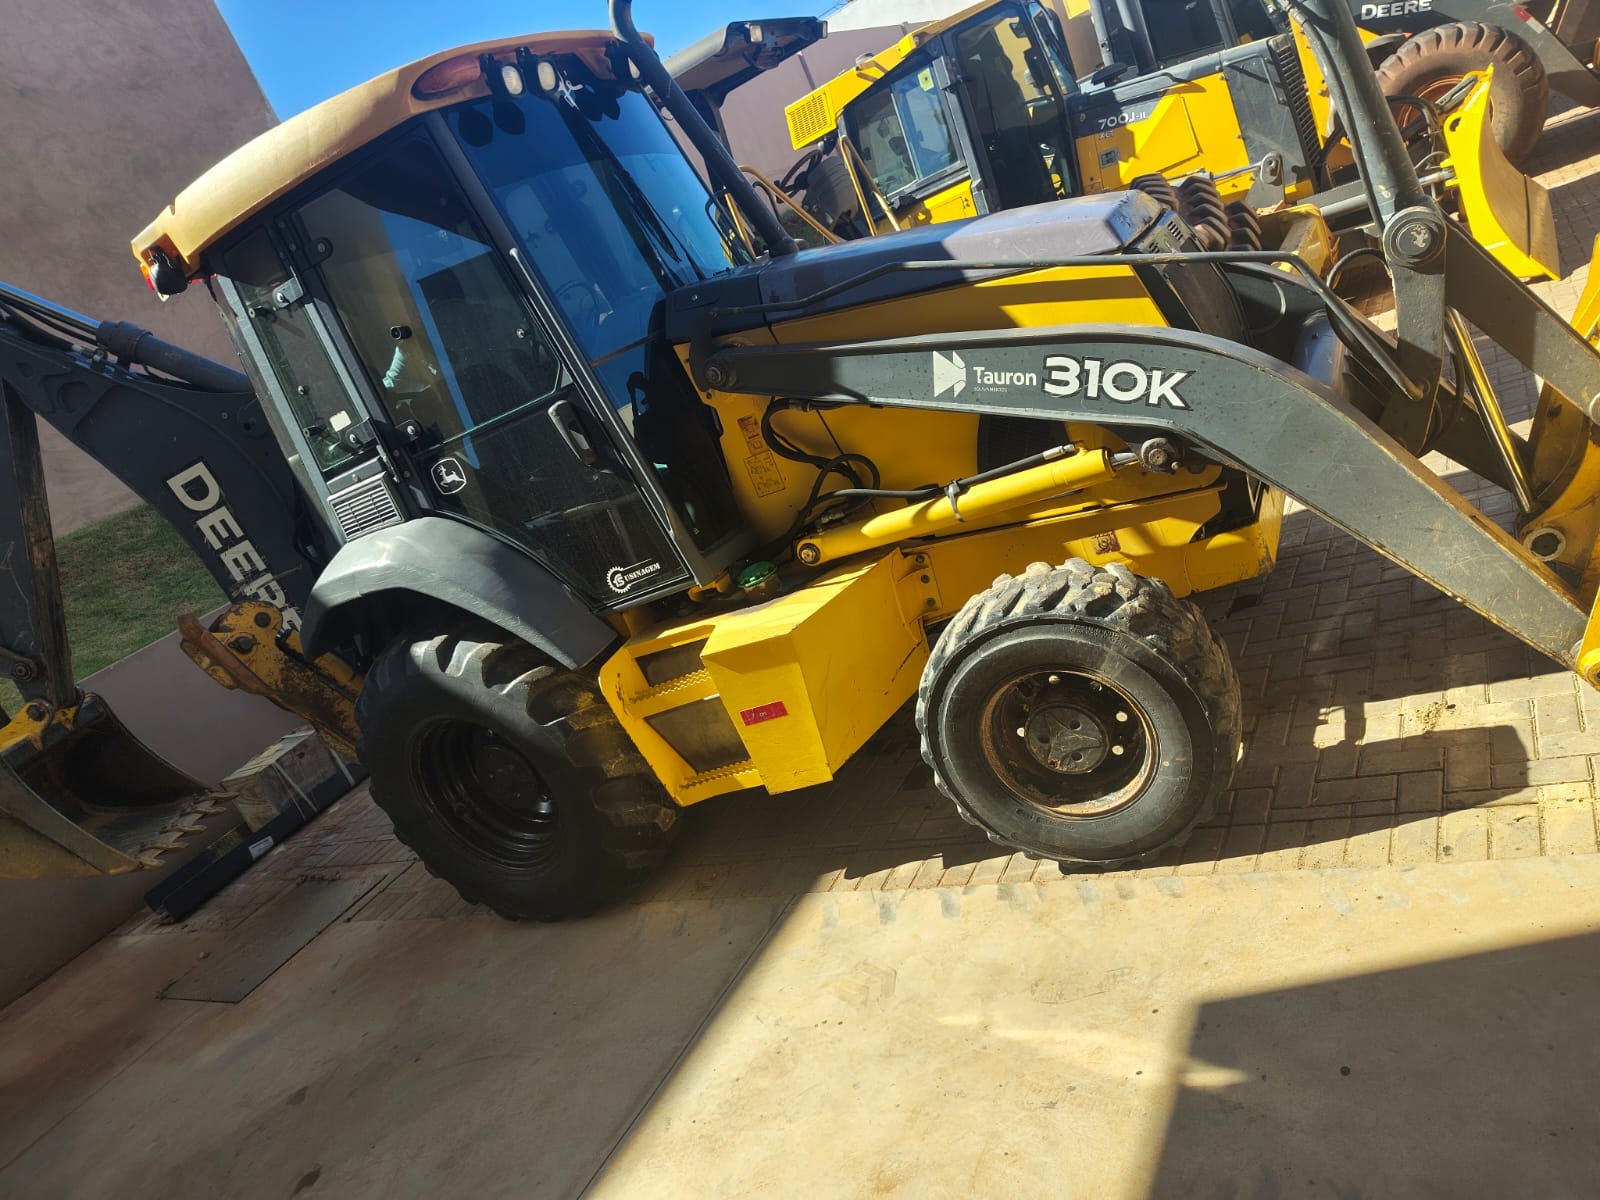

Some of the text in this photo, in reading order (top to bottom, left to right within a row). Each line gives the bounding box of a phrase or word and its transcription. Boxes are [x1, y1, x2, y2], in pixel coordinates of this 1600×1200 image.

[1361, 0, 1432, 20] DEERE
[973, 366, 1037, 386] Tauron
[1043, 355, 1189, 408] 310K
